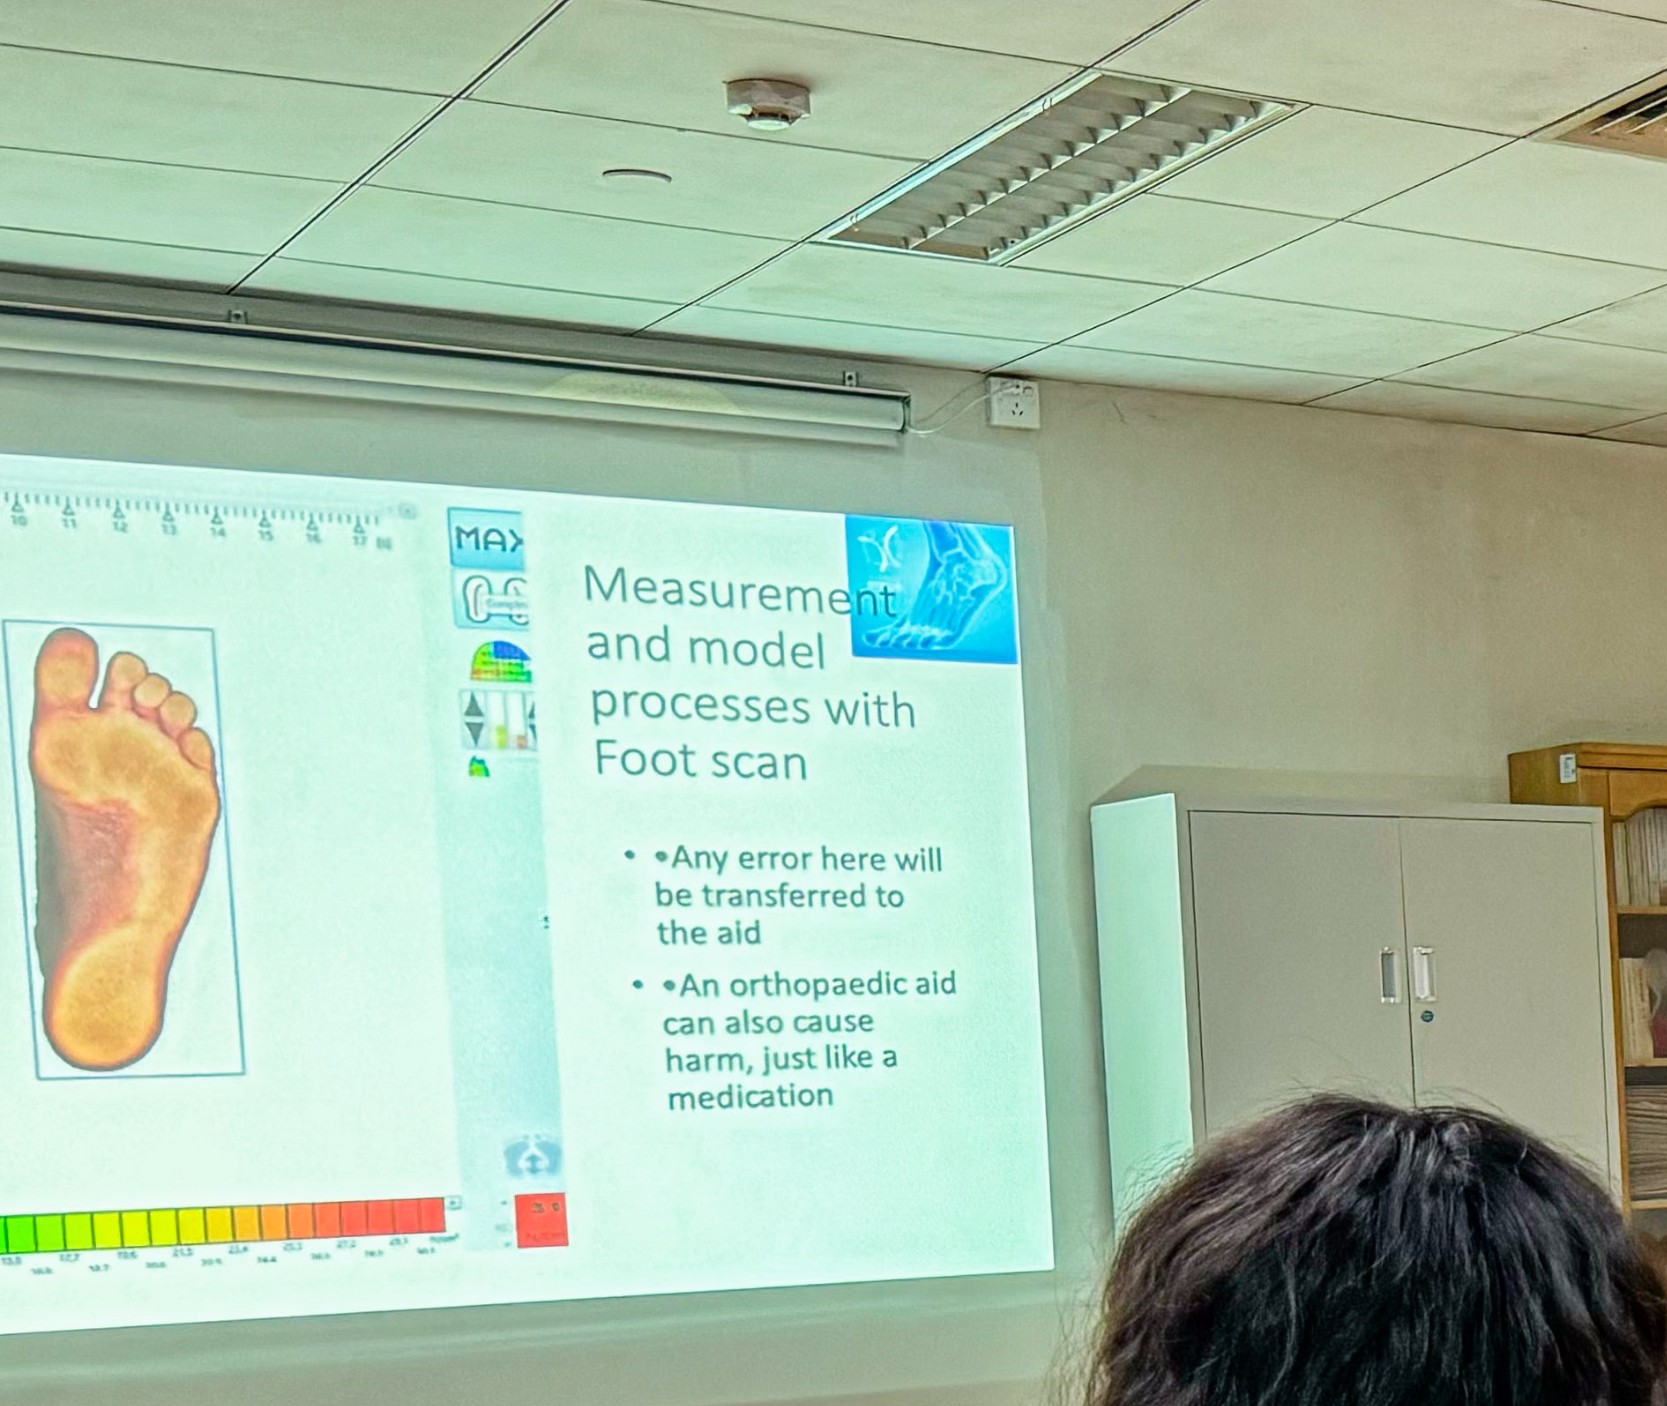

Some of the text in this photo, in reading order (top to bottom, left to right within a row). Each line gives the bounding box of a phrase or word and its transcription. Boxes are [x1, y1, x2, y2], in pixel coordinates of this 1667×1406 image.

[584, 565, 897, 618] Measurement
[587, 626, 826, 670] and model
[592, 687, 916, 728] processes with
[595, 739, 808, 780] Foot scan
[671, 845, 943, 874] Any error here will
[655, 881, 905, 908] be transferred to
[658, 920, 761, 946] the aid
[679, 970, 957, 1002] An orthopaedic aid
[663, 1009, 874, 1036] can also cause
[666, 1043, 898, 1077] harm, just like a
[668, 1084, 834, 1112] medication
